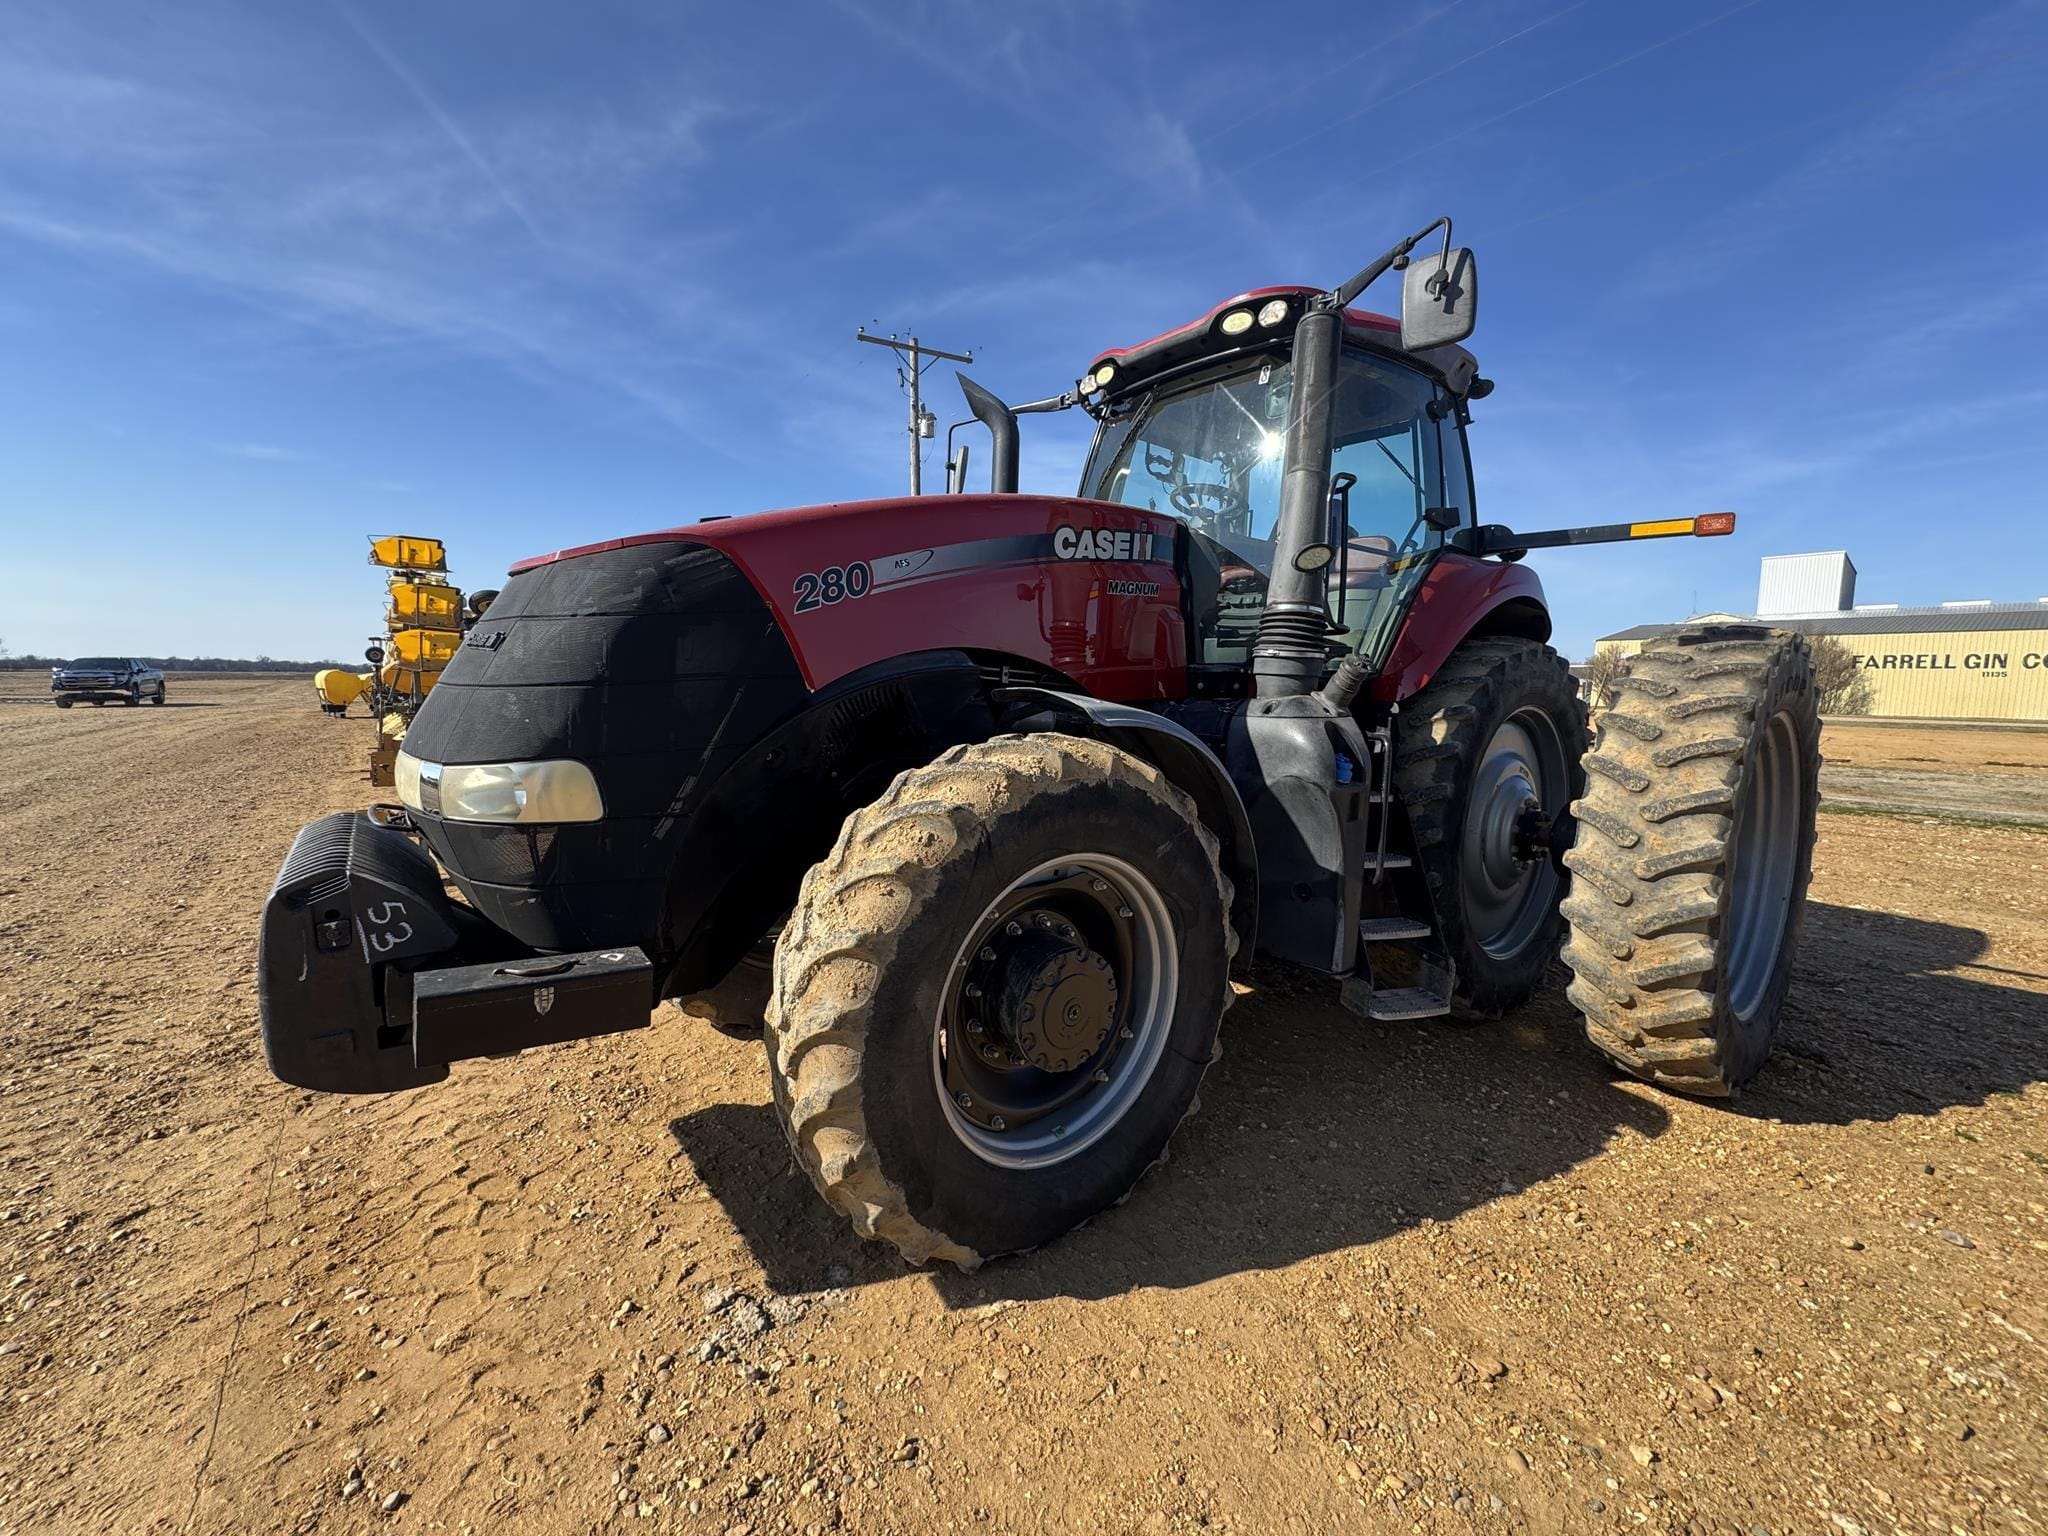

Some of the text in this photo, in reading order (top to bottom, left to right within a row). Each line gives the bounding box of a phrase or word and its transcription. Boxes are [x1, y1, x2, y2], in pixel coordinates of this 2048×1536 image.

[894, 558, 910, 569] AFS
[793, 561, 870, 614] 280
[1107, 580, 1160, 597] MAGNUM
[1851, 654, 1957, 669] FARRELL
[1963, 653, 2008, 669] GIN
[368, 901, 413, 952] 53
